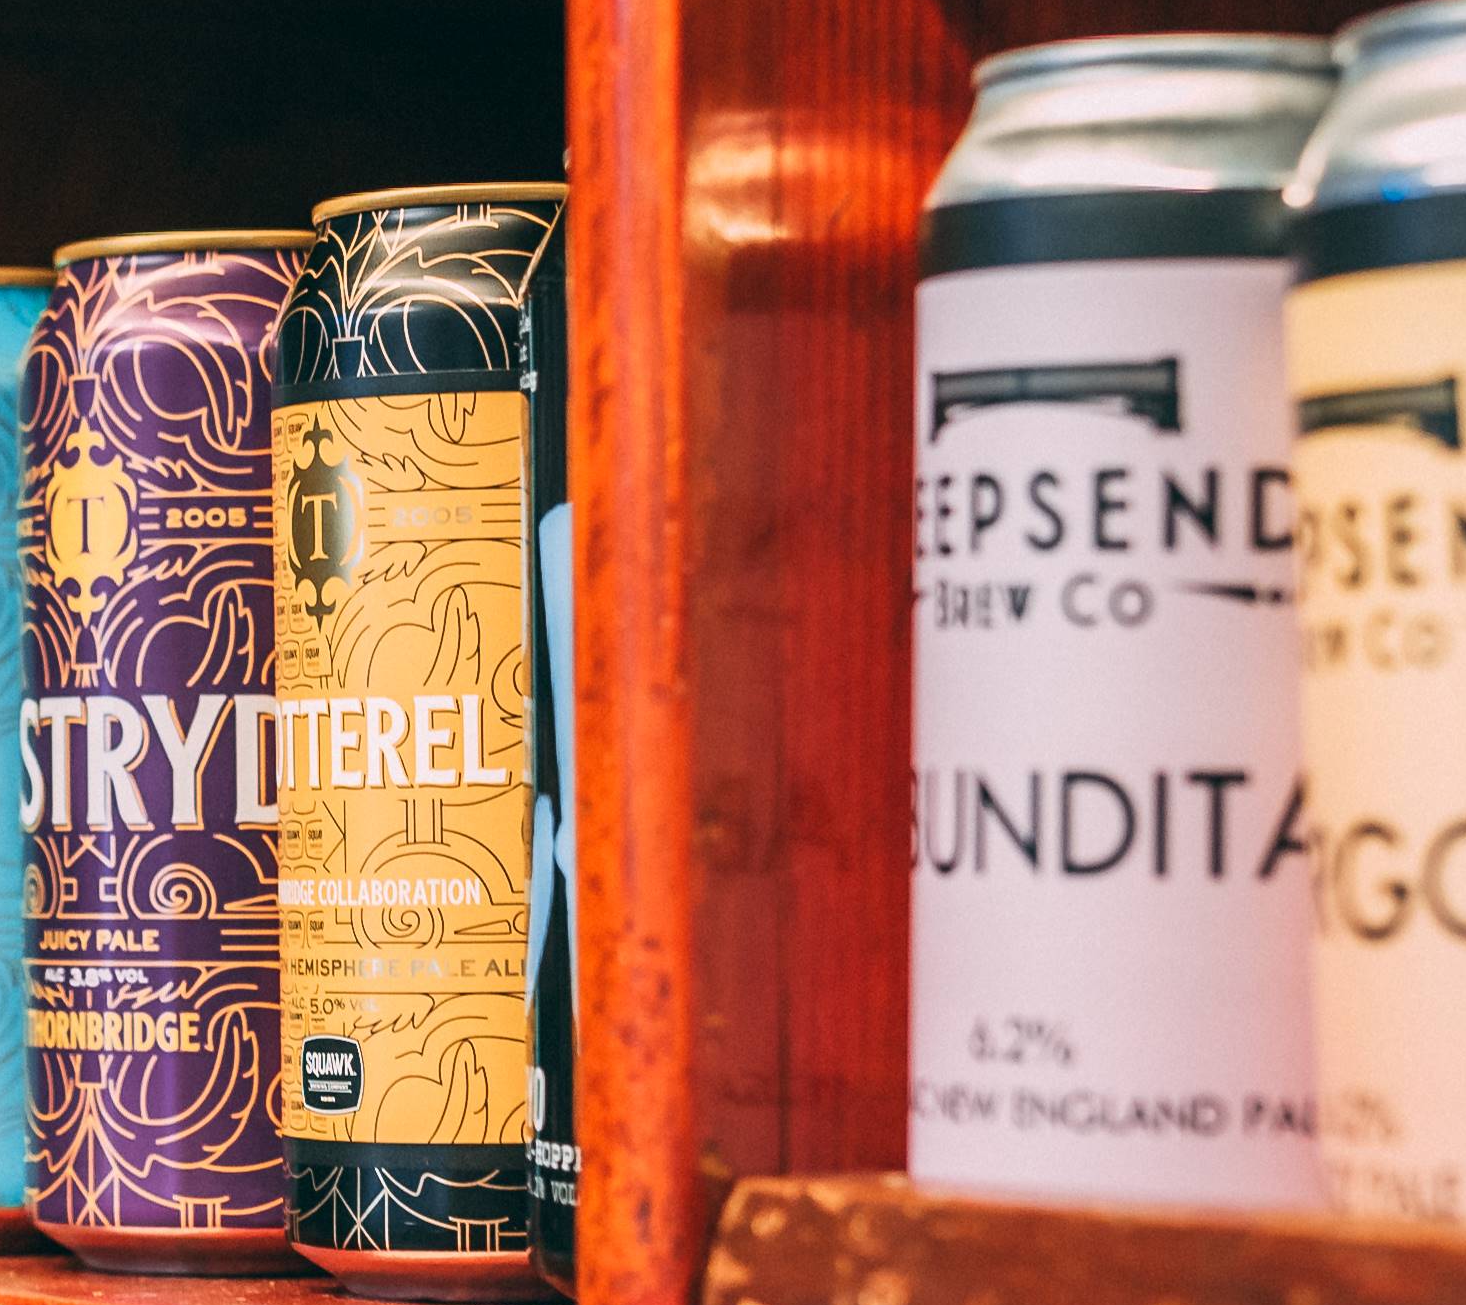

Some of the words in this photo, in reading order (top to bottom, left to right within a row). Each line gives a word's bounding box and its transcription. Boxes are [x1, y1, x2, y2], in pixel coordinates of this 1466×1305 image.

[67, 496, 105, 554] T
[165, 506, 248, 529] 2005
[301, 494, 338, 562] T
[392, 504, 474, 529] 2005
[317, 877, 481, 907] COLLABORATION
[39, 928, 92, 952] JUICY
[95, 928, 161, 953] PALE
[68, 967, 113, 989] 3.8%
[114, 967, 149, 986] VOL
[290, 957, 404, 978] HEMISPHERE
[410, 957, 477, 978] PALE
[309, 997, 346, 1016] 5.0%
[527, 1138, 582, 1174] -HOPP
